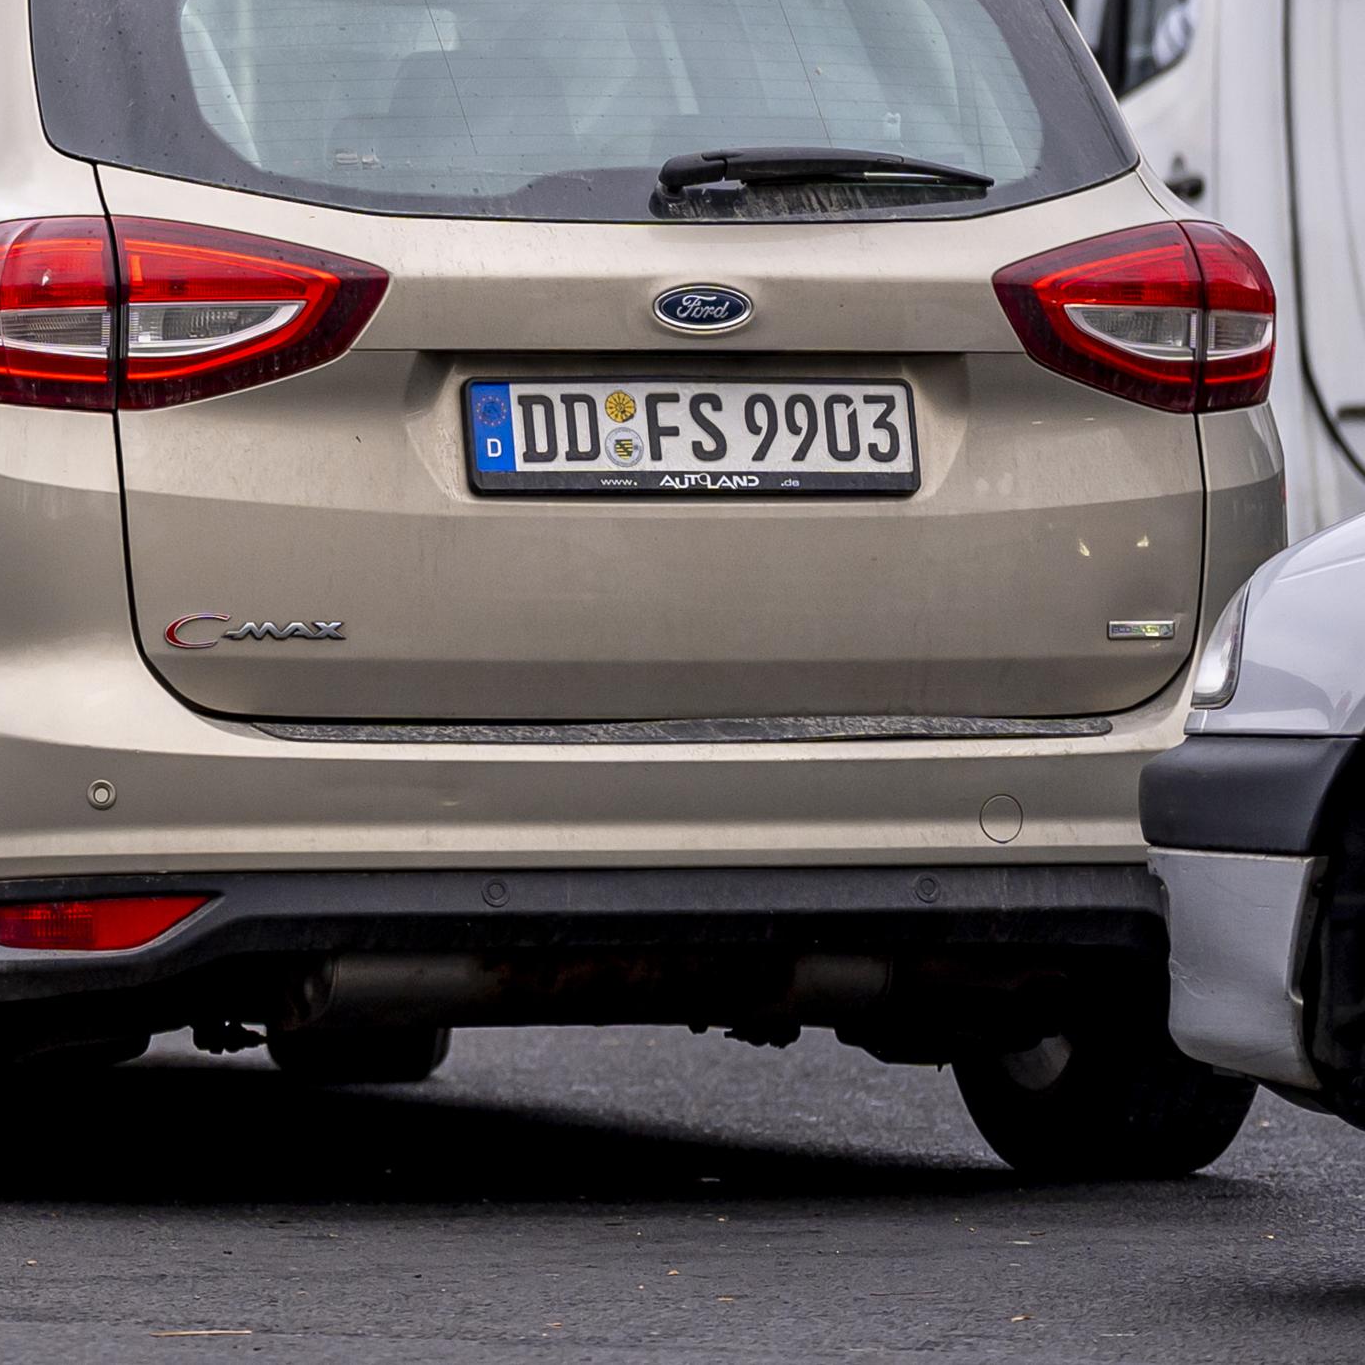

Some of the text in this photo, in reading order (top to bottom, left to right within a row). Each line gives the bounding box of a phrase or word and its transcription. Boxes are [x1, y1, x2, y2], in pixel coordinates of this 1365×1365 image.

[676, 295, 729, 321] Ford
[517, 392, 901, 463] DD FS 9903
[487, 438, 502, 458] D
